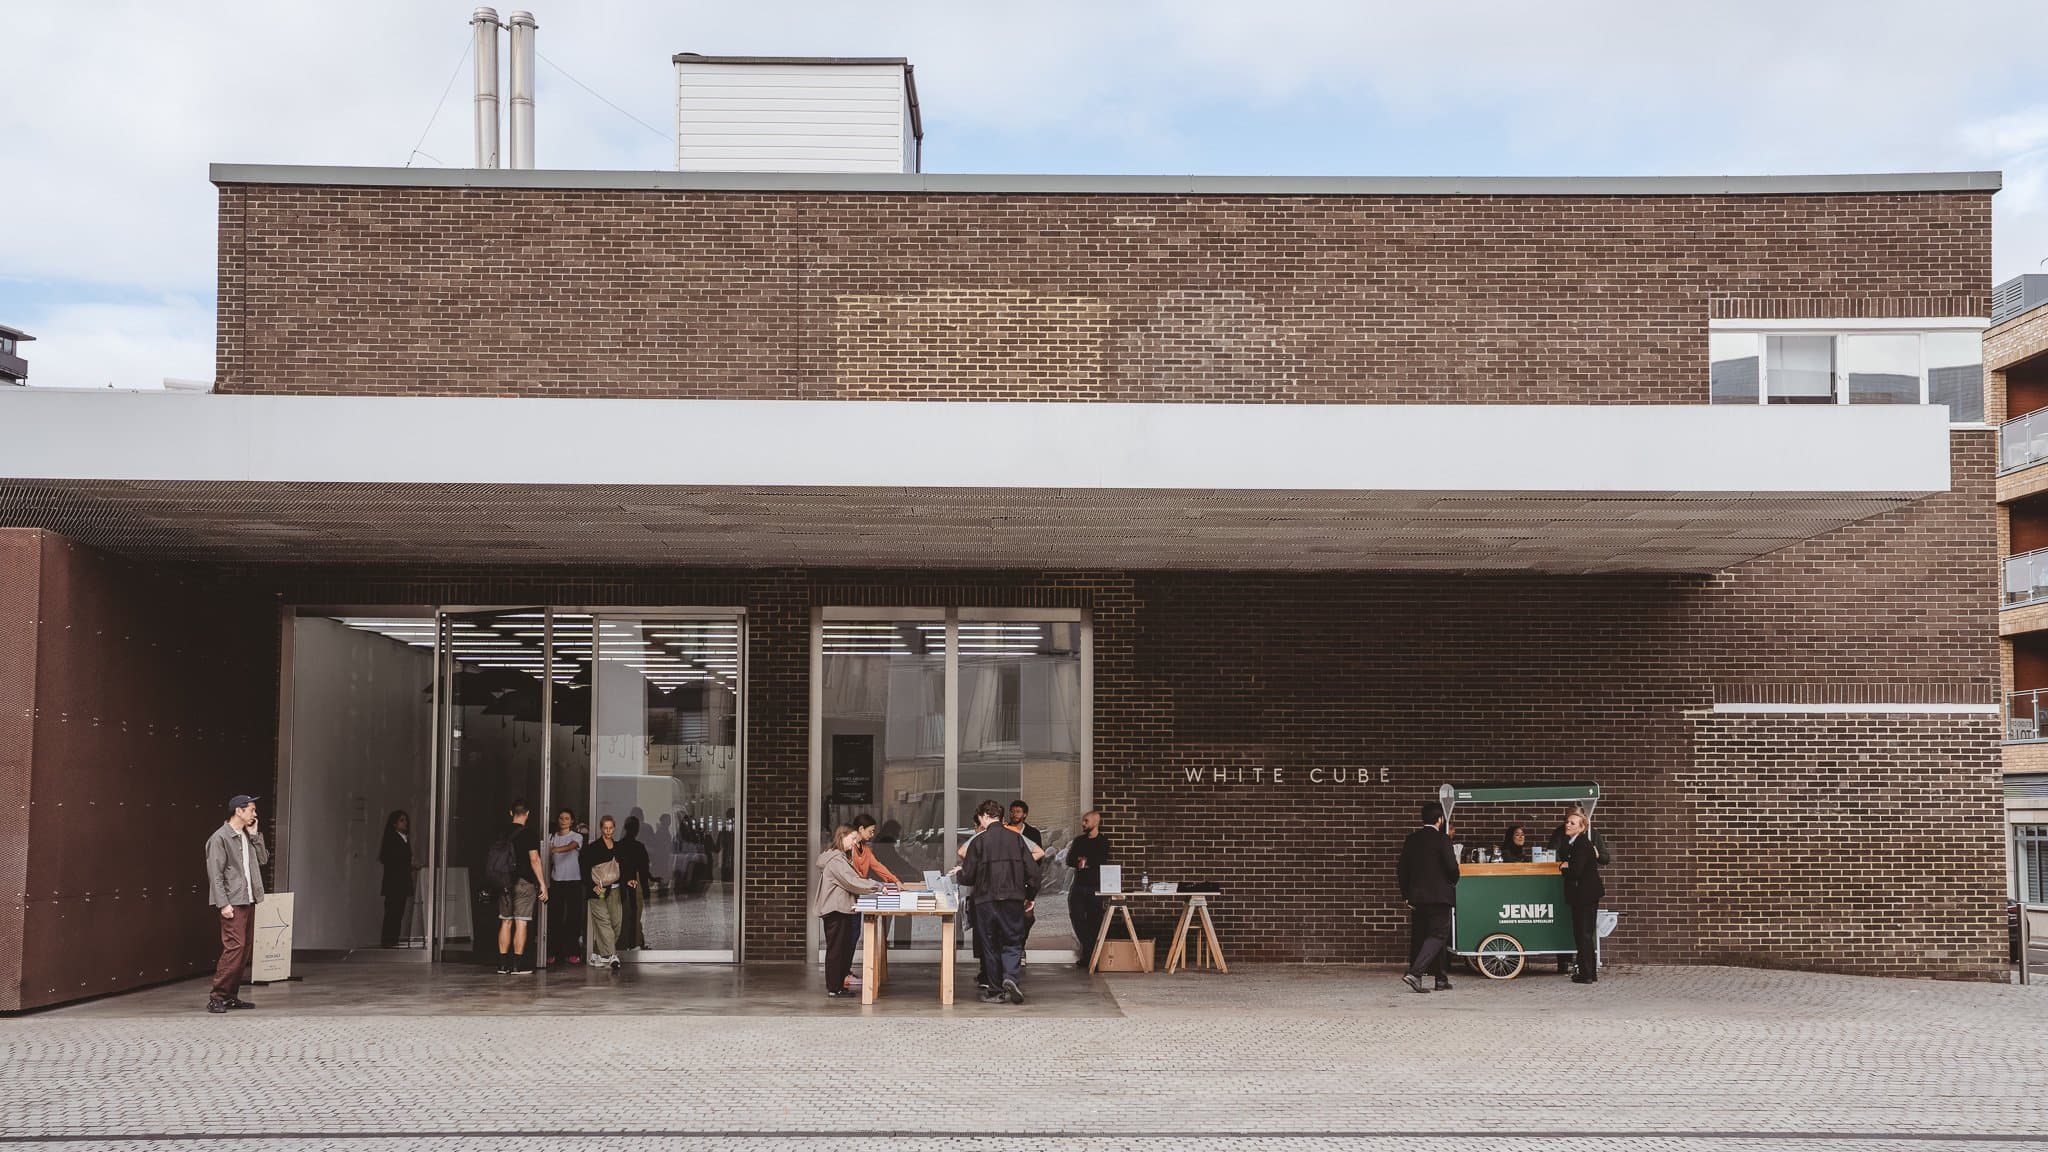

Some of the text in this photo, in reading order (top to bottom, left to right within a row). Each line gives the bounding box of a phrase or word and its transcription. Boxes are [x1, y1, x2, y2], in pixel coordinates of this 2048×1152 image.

[1185, 768, 1390, 783] WHITE CUBE
[1498, 903, 1554, 919] JENKI
